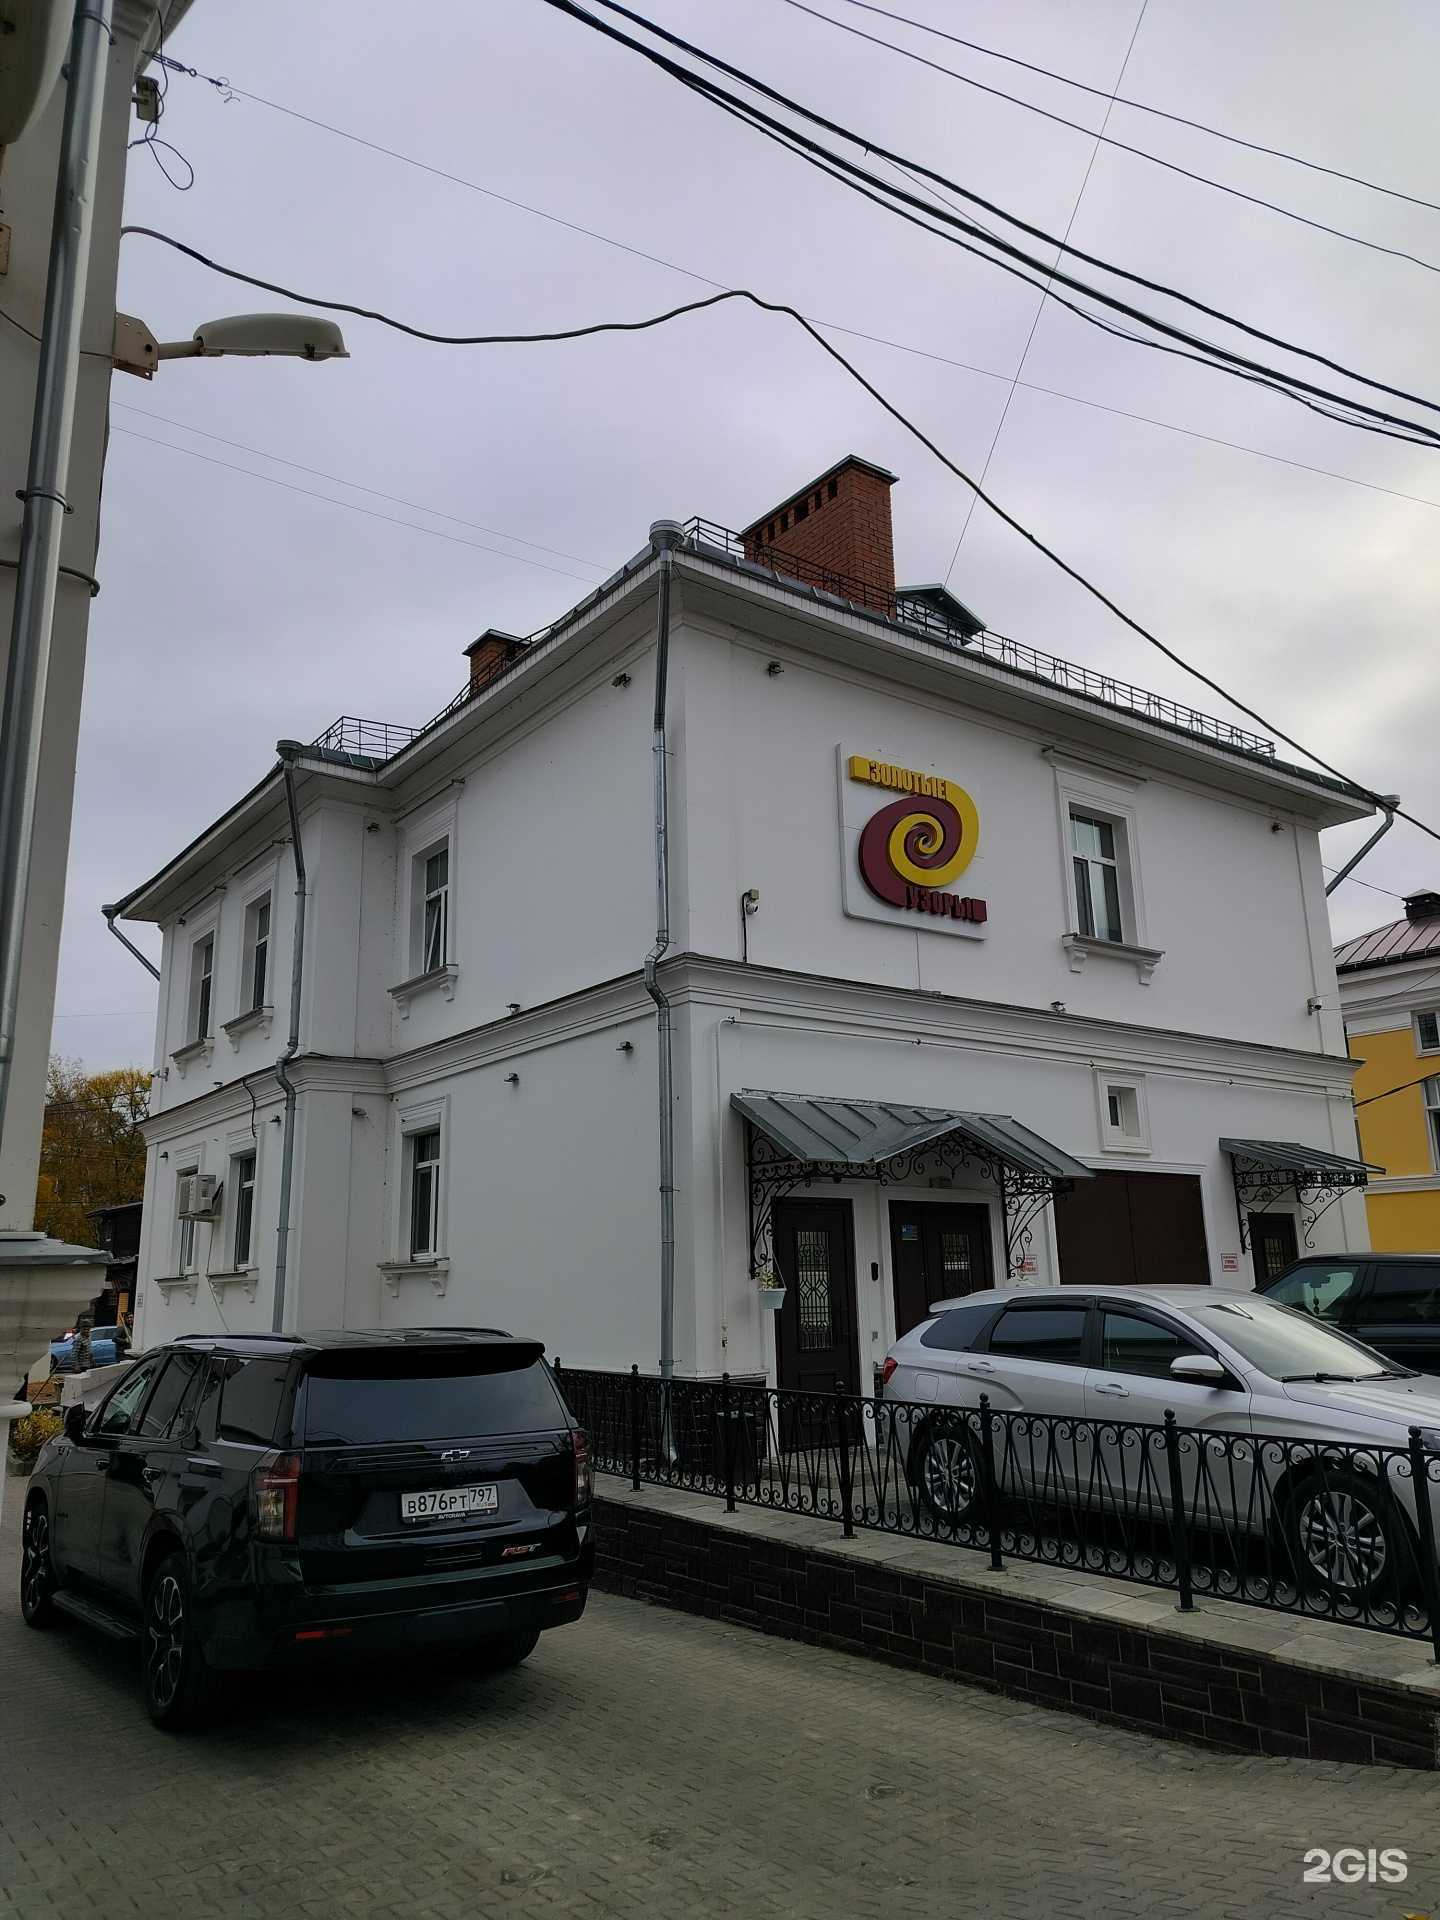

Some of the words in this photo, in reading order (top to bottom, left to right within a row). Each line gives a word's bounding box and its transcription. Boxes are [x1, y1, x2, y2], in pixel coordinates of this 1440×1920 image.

[869, 760, 947, 800] ЗОЛОТЫЕ
[907, 887, 973, 921] УЗОРЫ
[470, 1488, 493, 1503] 797
